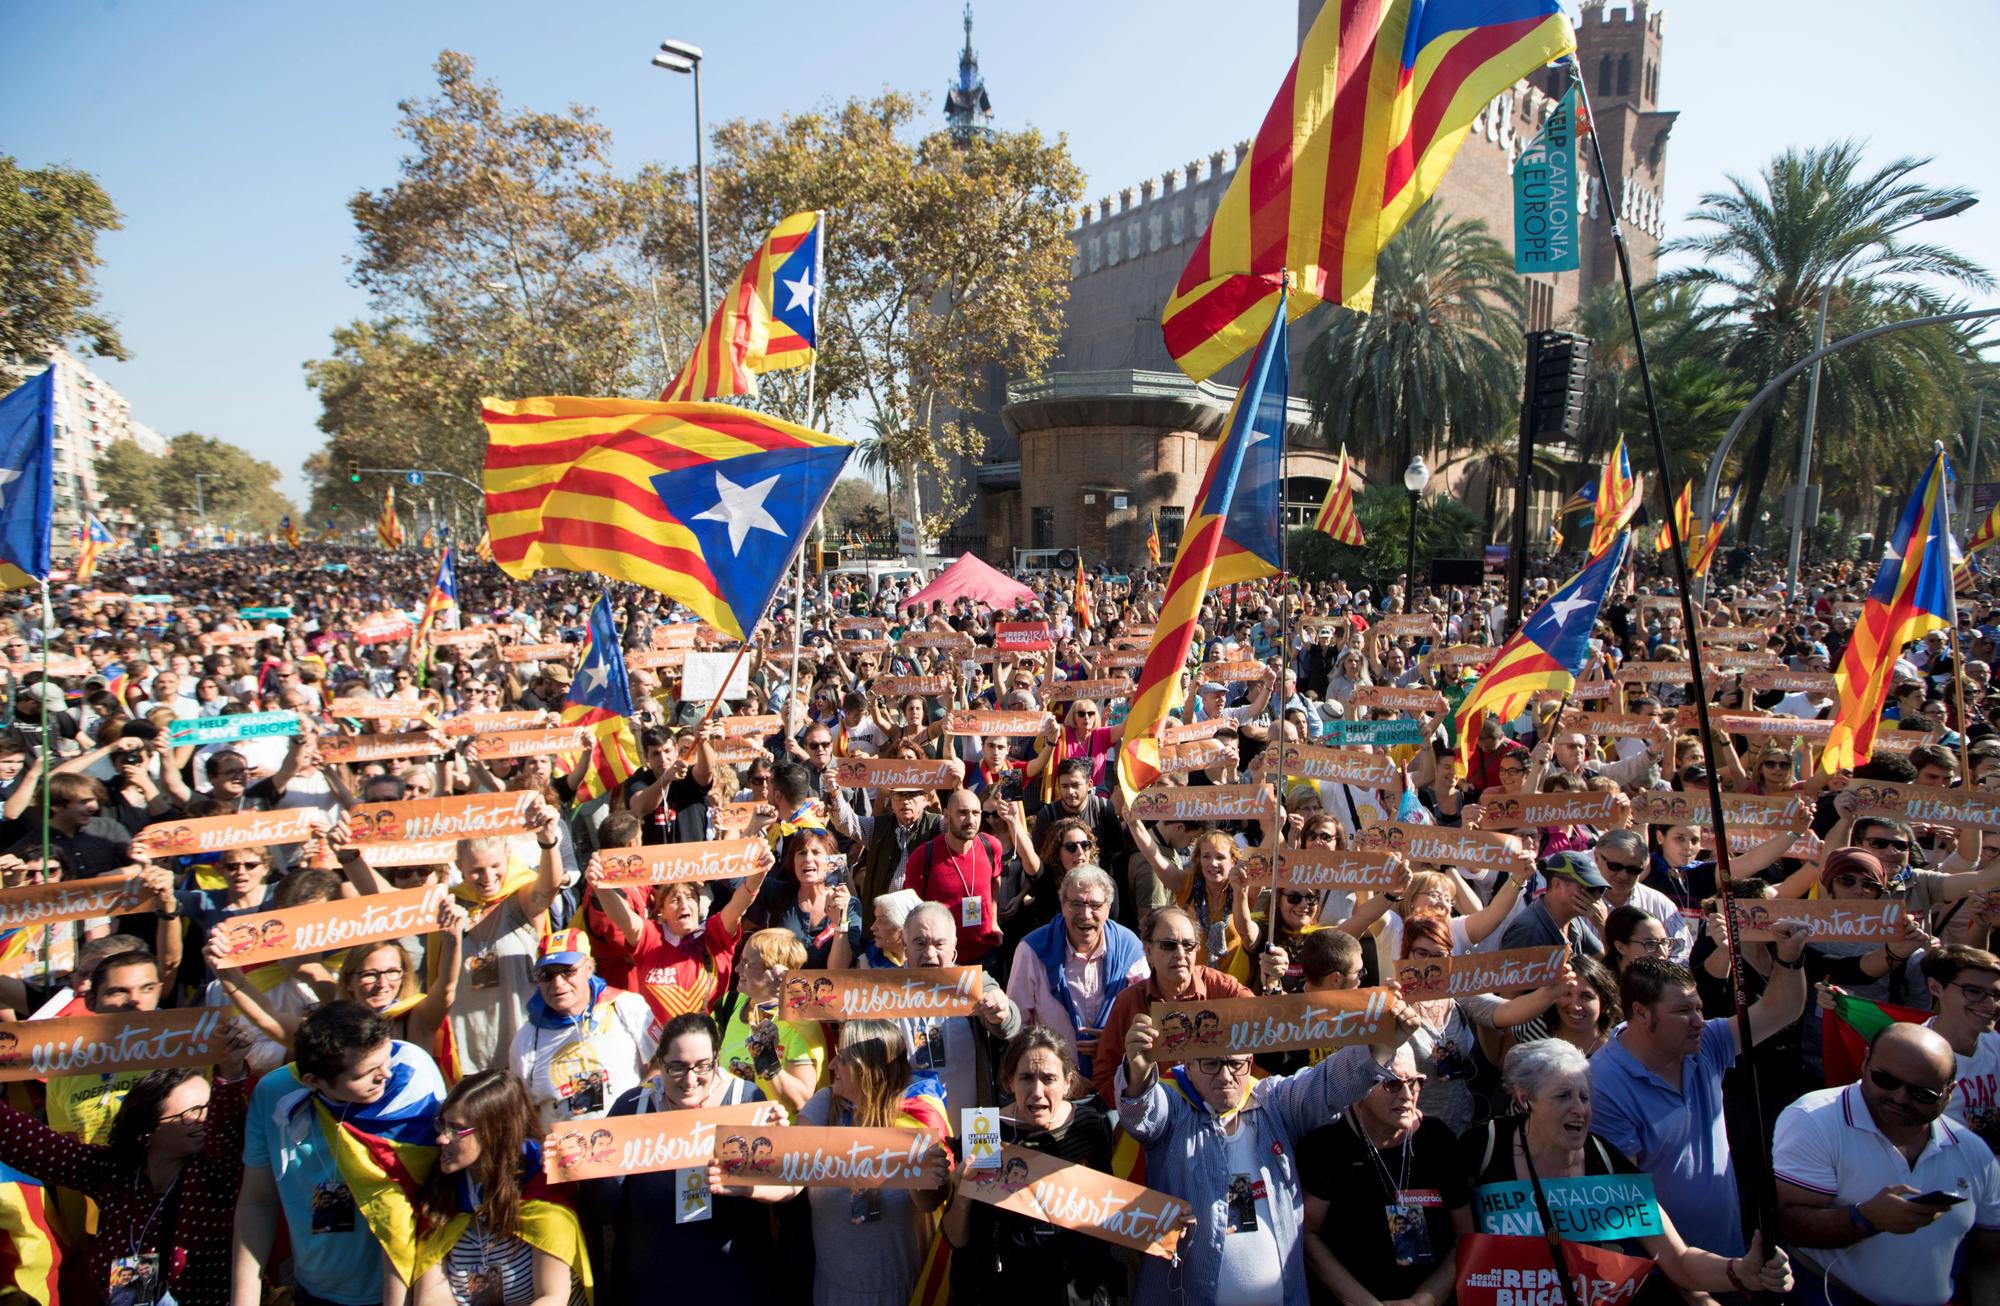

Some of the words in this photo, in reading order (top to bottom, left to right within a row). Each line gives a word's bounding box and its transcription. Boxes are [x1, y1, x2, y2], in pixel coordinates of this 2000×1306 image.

[1523, 169, 1548, 263] EUROPE
[1549, 151, 1569, 261] CATALONIA
[198, 718, 229, 729] HELP
[198, 727, 239, 740] SAVE
[240, 720, 300, 736] EUROPE
[1345, 724, 1369, 733] HELP
[1369, 722, 1418, 732] CATALONIA
[1345, 732, 1375, 743] SAVE
[1376, 730, 1420, 742] EUROPE
[841, 970, 973, 1014] llibertat!!
[1226, 991, 1388, 1050] llibertat!!
[30, 1010, 220, 1074] llibertat!!
[779, 1133, 933, 1182] llibertat!!
[1030, 1182, 1182, 1243] llibertat!!
[1481, 1190, 1526, 1214] HELP
[1529, 1183, 1646, 1209] CATALONIA
[1552, 1203, 1652, 1234] EUROPE
[1466, 1279, 1503, 1288] TREBALL
